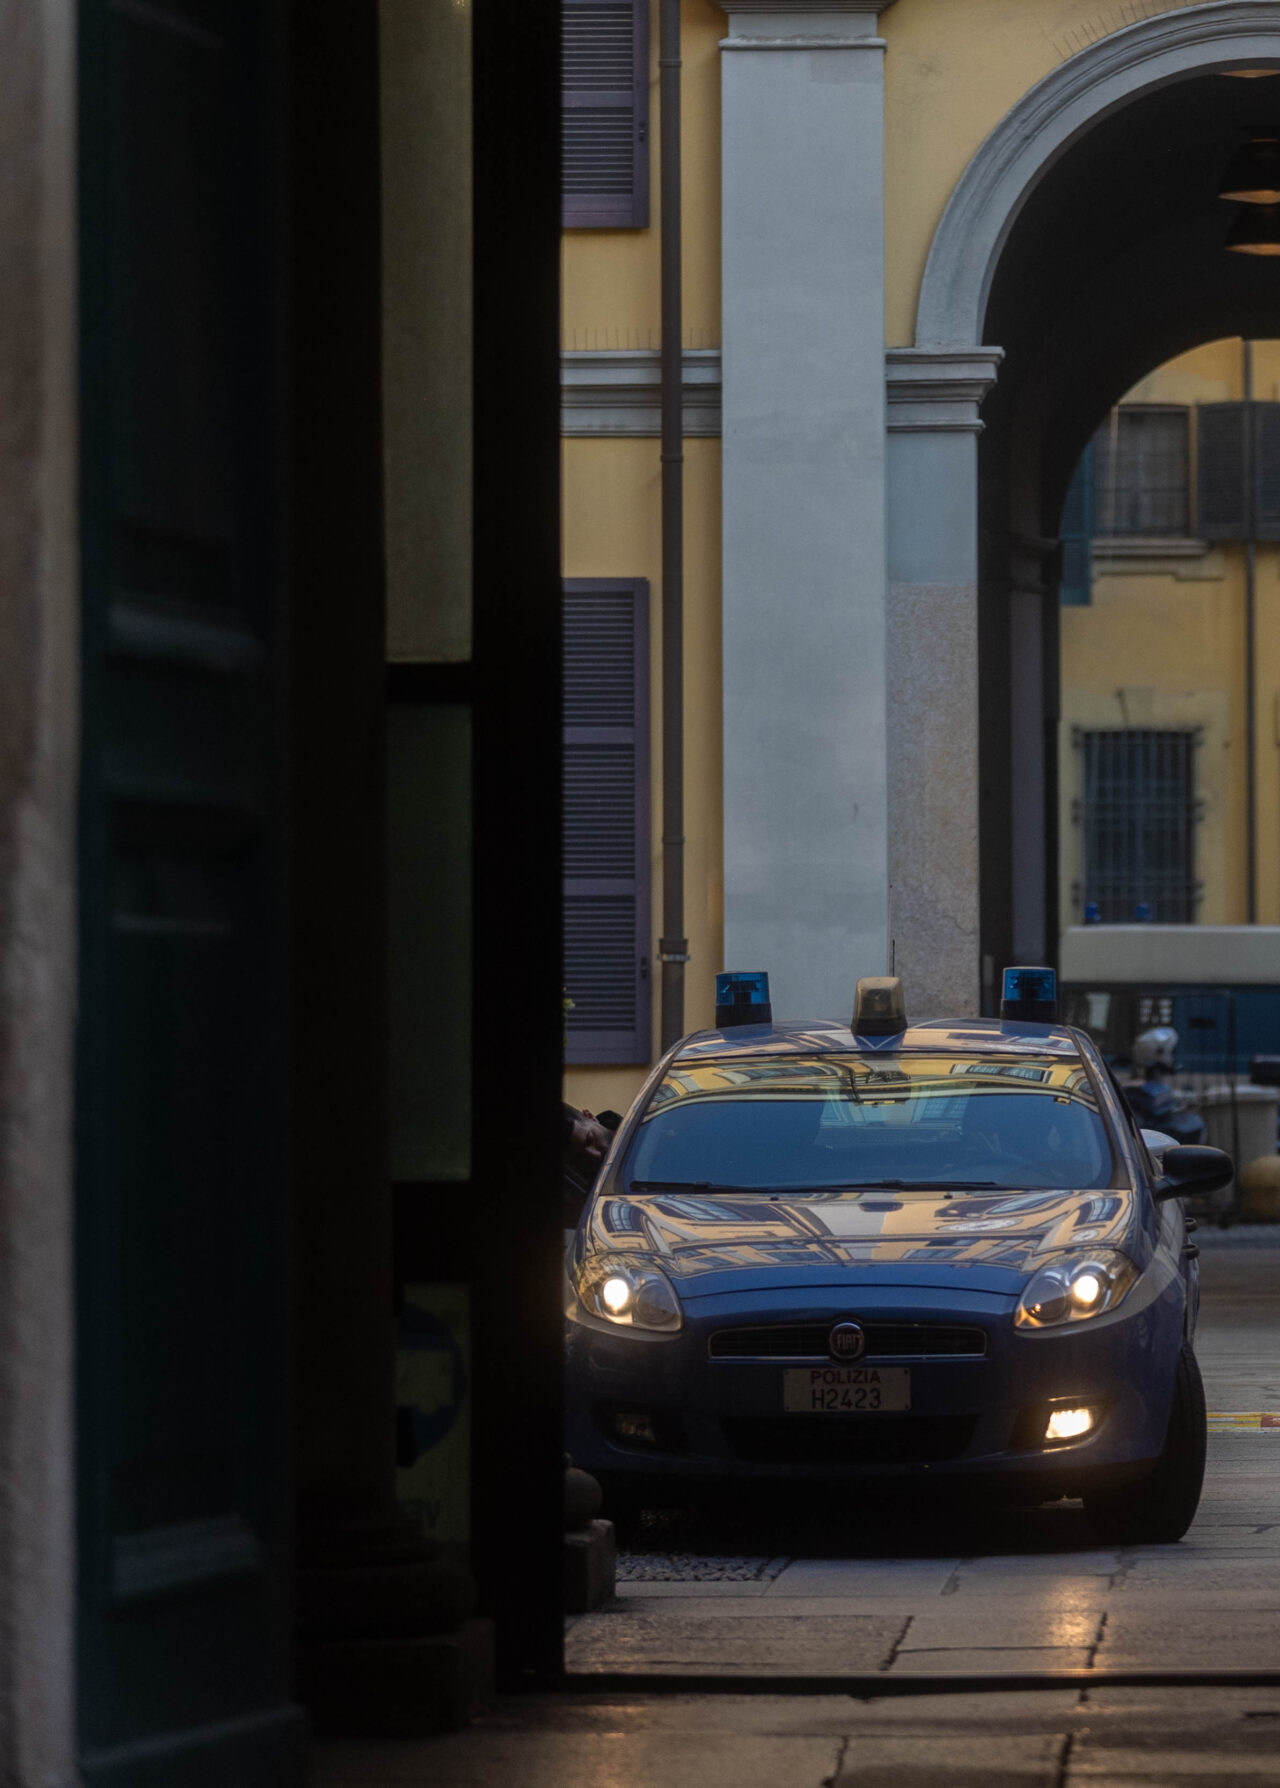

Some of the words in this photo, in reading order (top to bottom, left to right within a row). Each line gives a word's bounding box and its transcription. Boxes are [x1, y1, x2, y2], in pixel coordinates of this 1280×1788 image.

[837, 1334, 859, 1350] FIAT
[810, 1369, 881, 1385] POLIZIA
[811, 1388, 882, 1410] H2423
